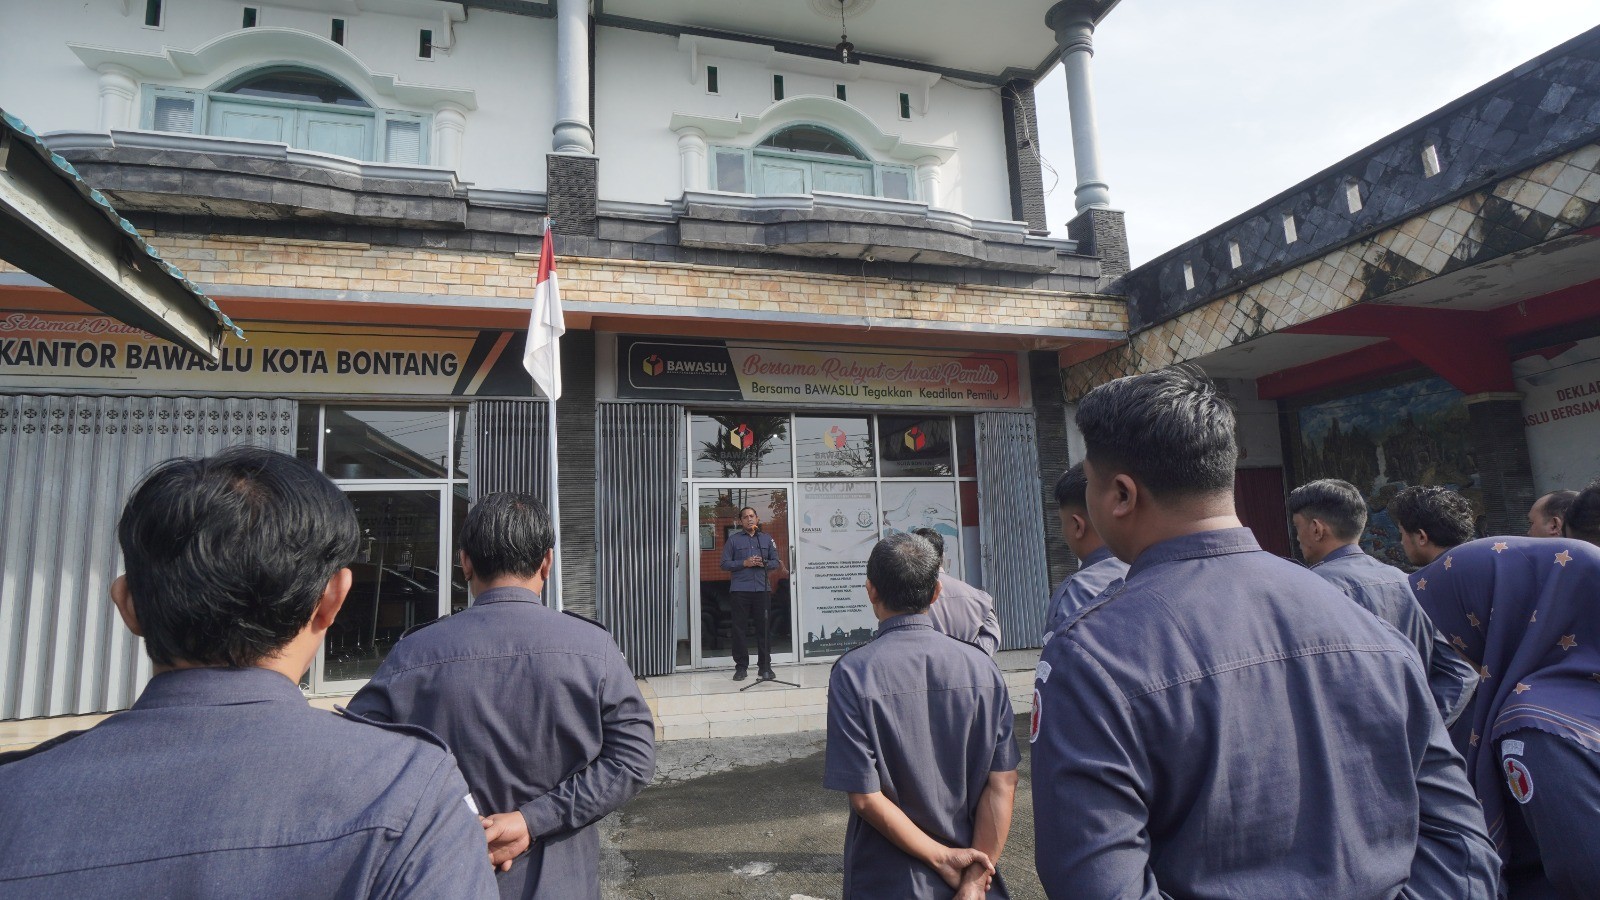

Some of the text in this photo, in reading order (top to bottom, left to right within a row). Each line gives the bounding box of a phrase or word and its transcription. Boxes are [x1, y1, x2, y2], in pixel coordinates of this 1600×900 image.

[0, 314, 88, 332] Selamat
[0, 339, 117, 369] KANTOR
[262, 349, 328, 374] KOTA
[336, 351, 458, 376] BONTANG
[667, 360, 727, 374] BAWASLU
[742, 353, 999, 385] Bersama Rakyat Awasi Pemilu
[751, 381, 999, 400] Bersama BAWASLU Tegakkan Keadilan Pemilu
